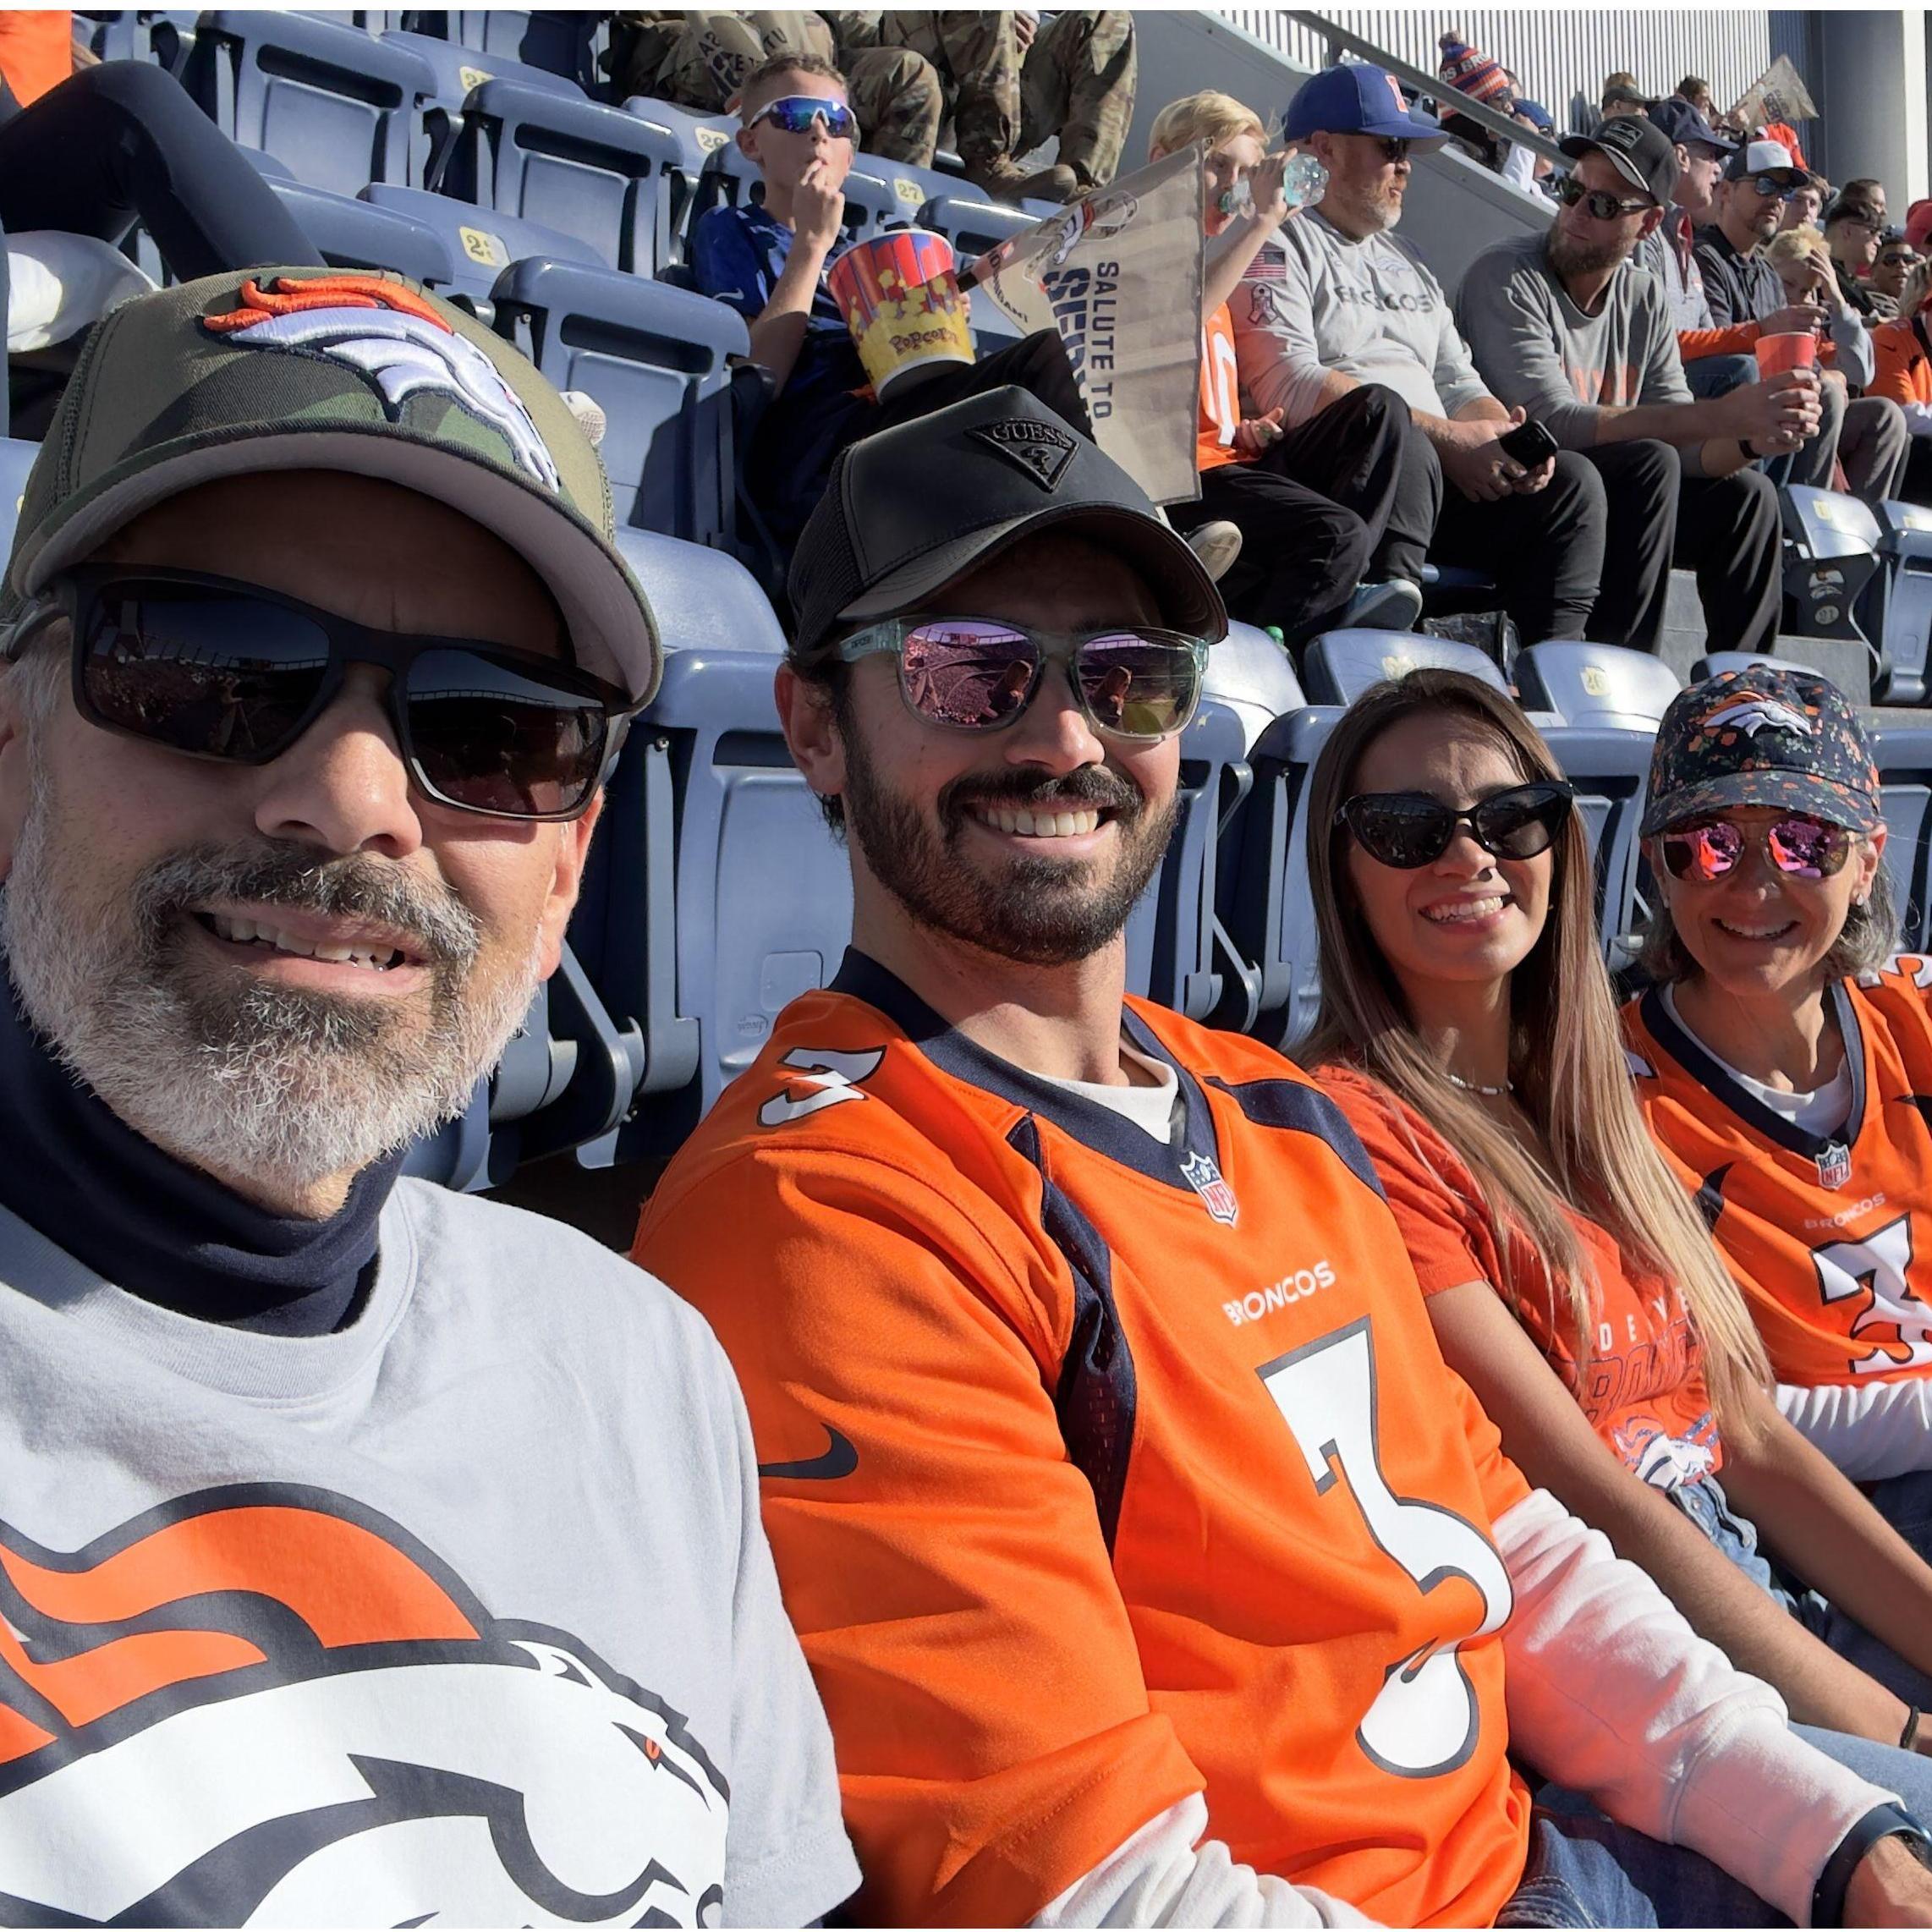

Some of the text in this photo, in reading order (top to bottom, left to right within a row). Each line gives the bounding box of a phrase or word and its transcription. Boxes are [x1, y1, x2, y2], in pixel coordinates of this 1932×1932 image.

[897, 183, 919, 200] 27
[1090, 261, 1120, 420] SALUTE TO
[992, 423, 1073, 449] GUESS
[756, 1044, 888, 1128] 3
[1823, 1161, 1848, 1184] NFL
[1803, 1192, 1886, 1229] BRONCOS
[1221, 1260, 1336, 1327] BRONCOS
[1257, 1314, 1514, 1779] 3
